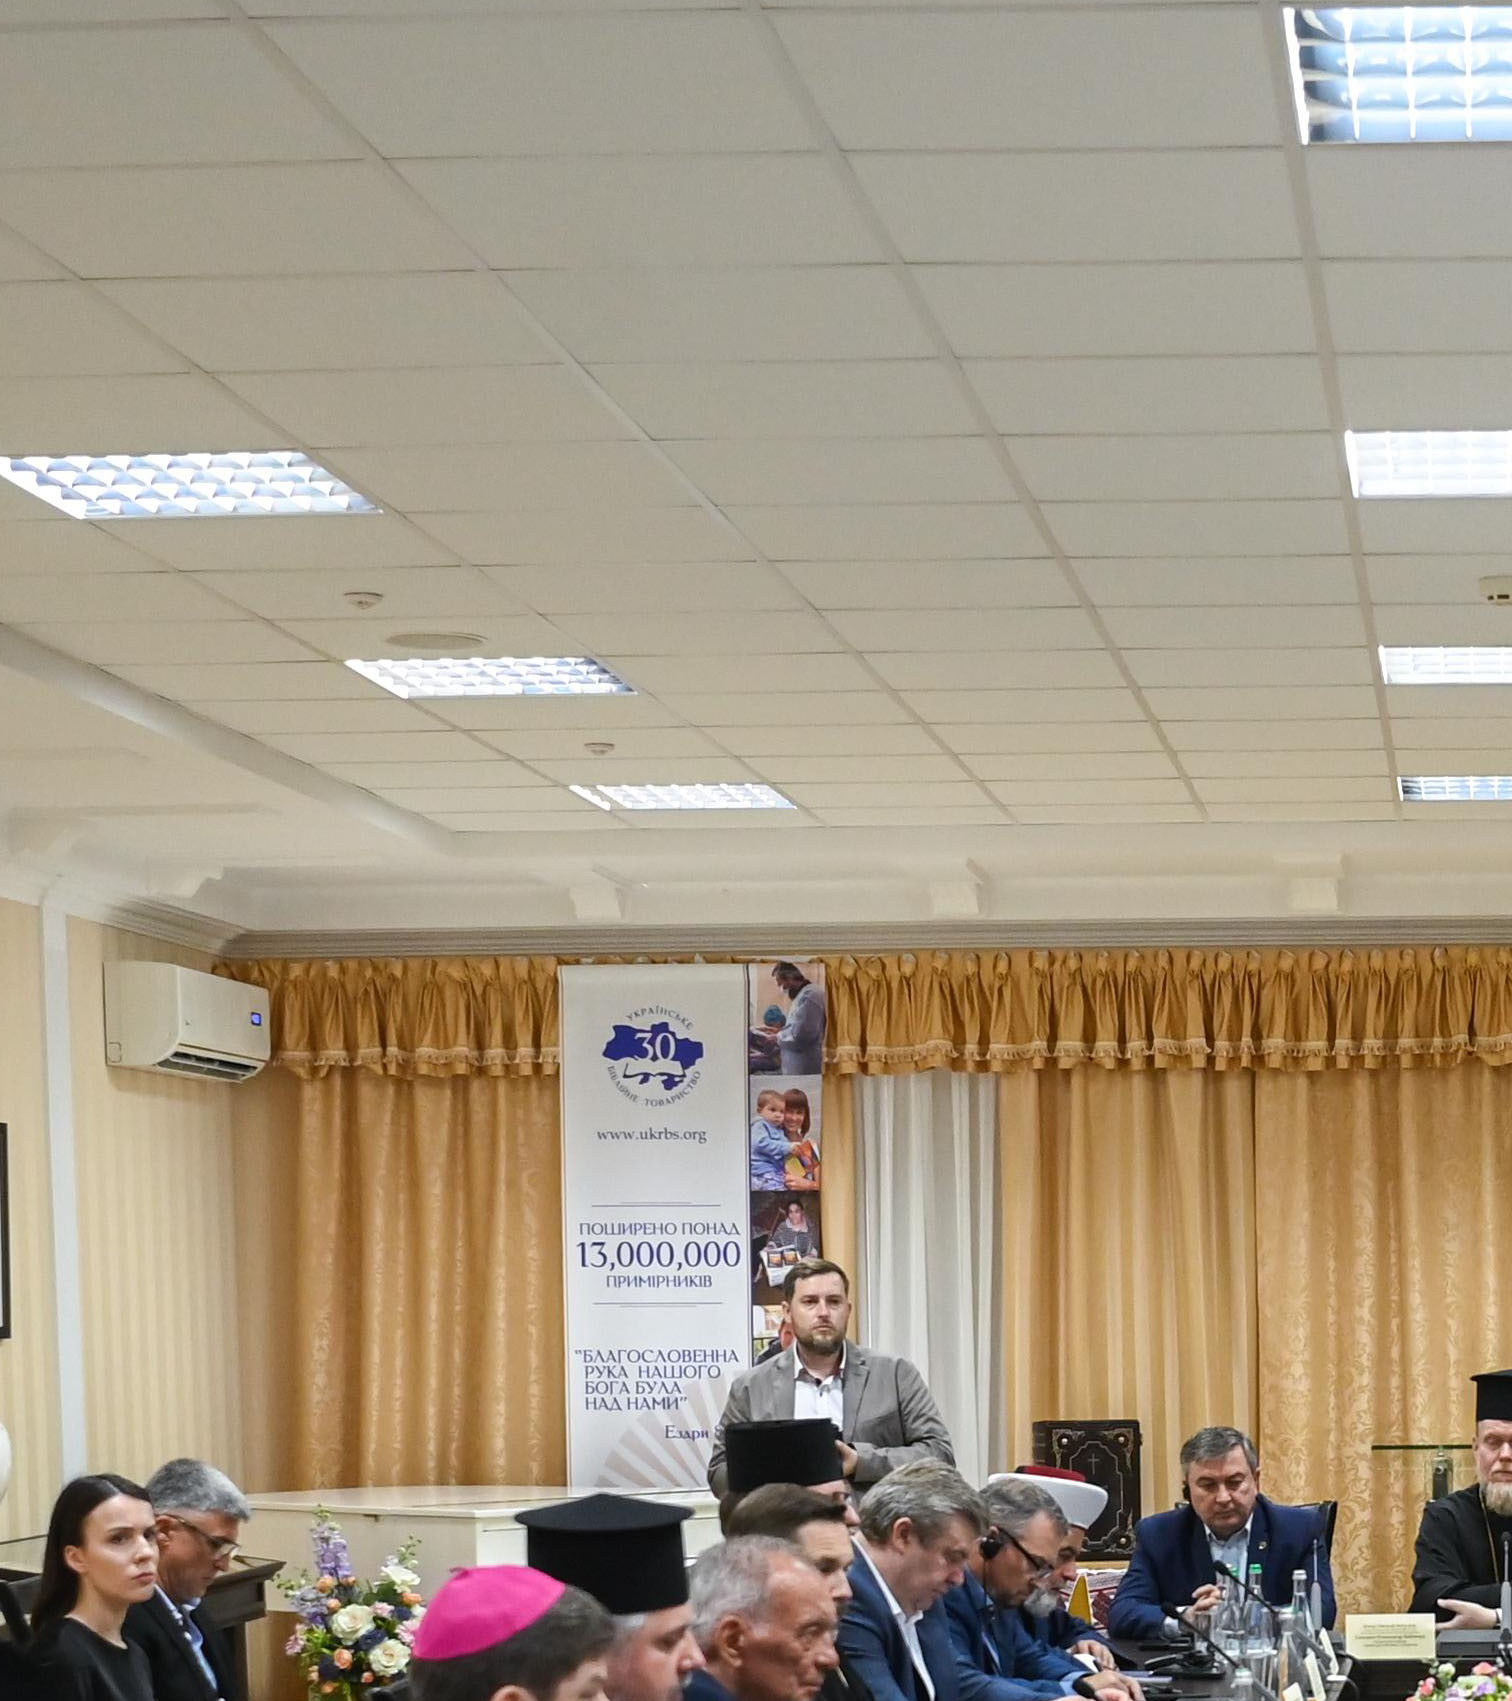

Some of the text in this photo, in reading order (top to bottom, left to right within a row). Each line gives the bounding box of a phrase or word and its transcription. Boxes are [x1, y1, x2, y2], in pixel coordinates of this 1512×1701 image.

[635, 1032, 676, 1061] 30
[596, 1127, 707, 1144] www.ukrbs.org
[579, 1222, 741, 1236] ПОШИРЕНО ПОНАД
[576, 1241, 741, 1271] 13,000,000
[606, 1275, 712, 1288] ПРИМІРНИКІВ
[585, 1365, 721, 1379] РУКА НАШОГО
[585, 1381, 682, 1395] БОГА БУЛА
[585, 1397, 623, 1411] НАД
[665, 1424, 709, 1442] Ездри
